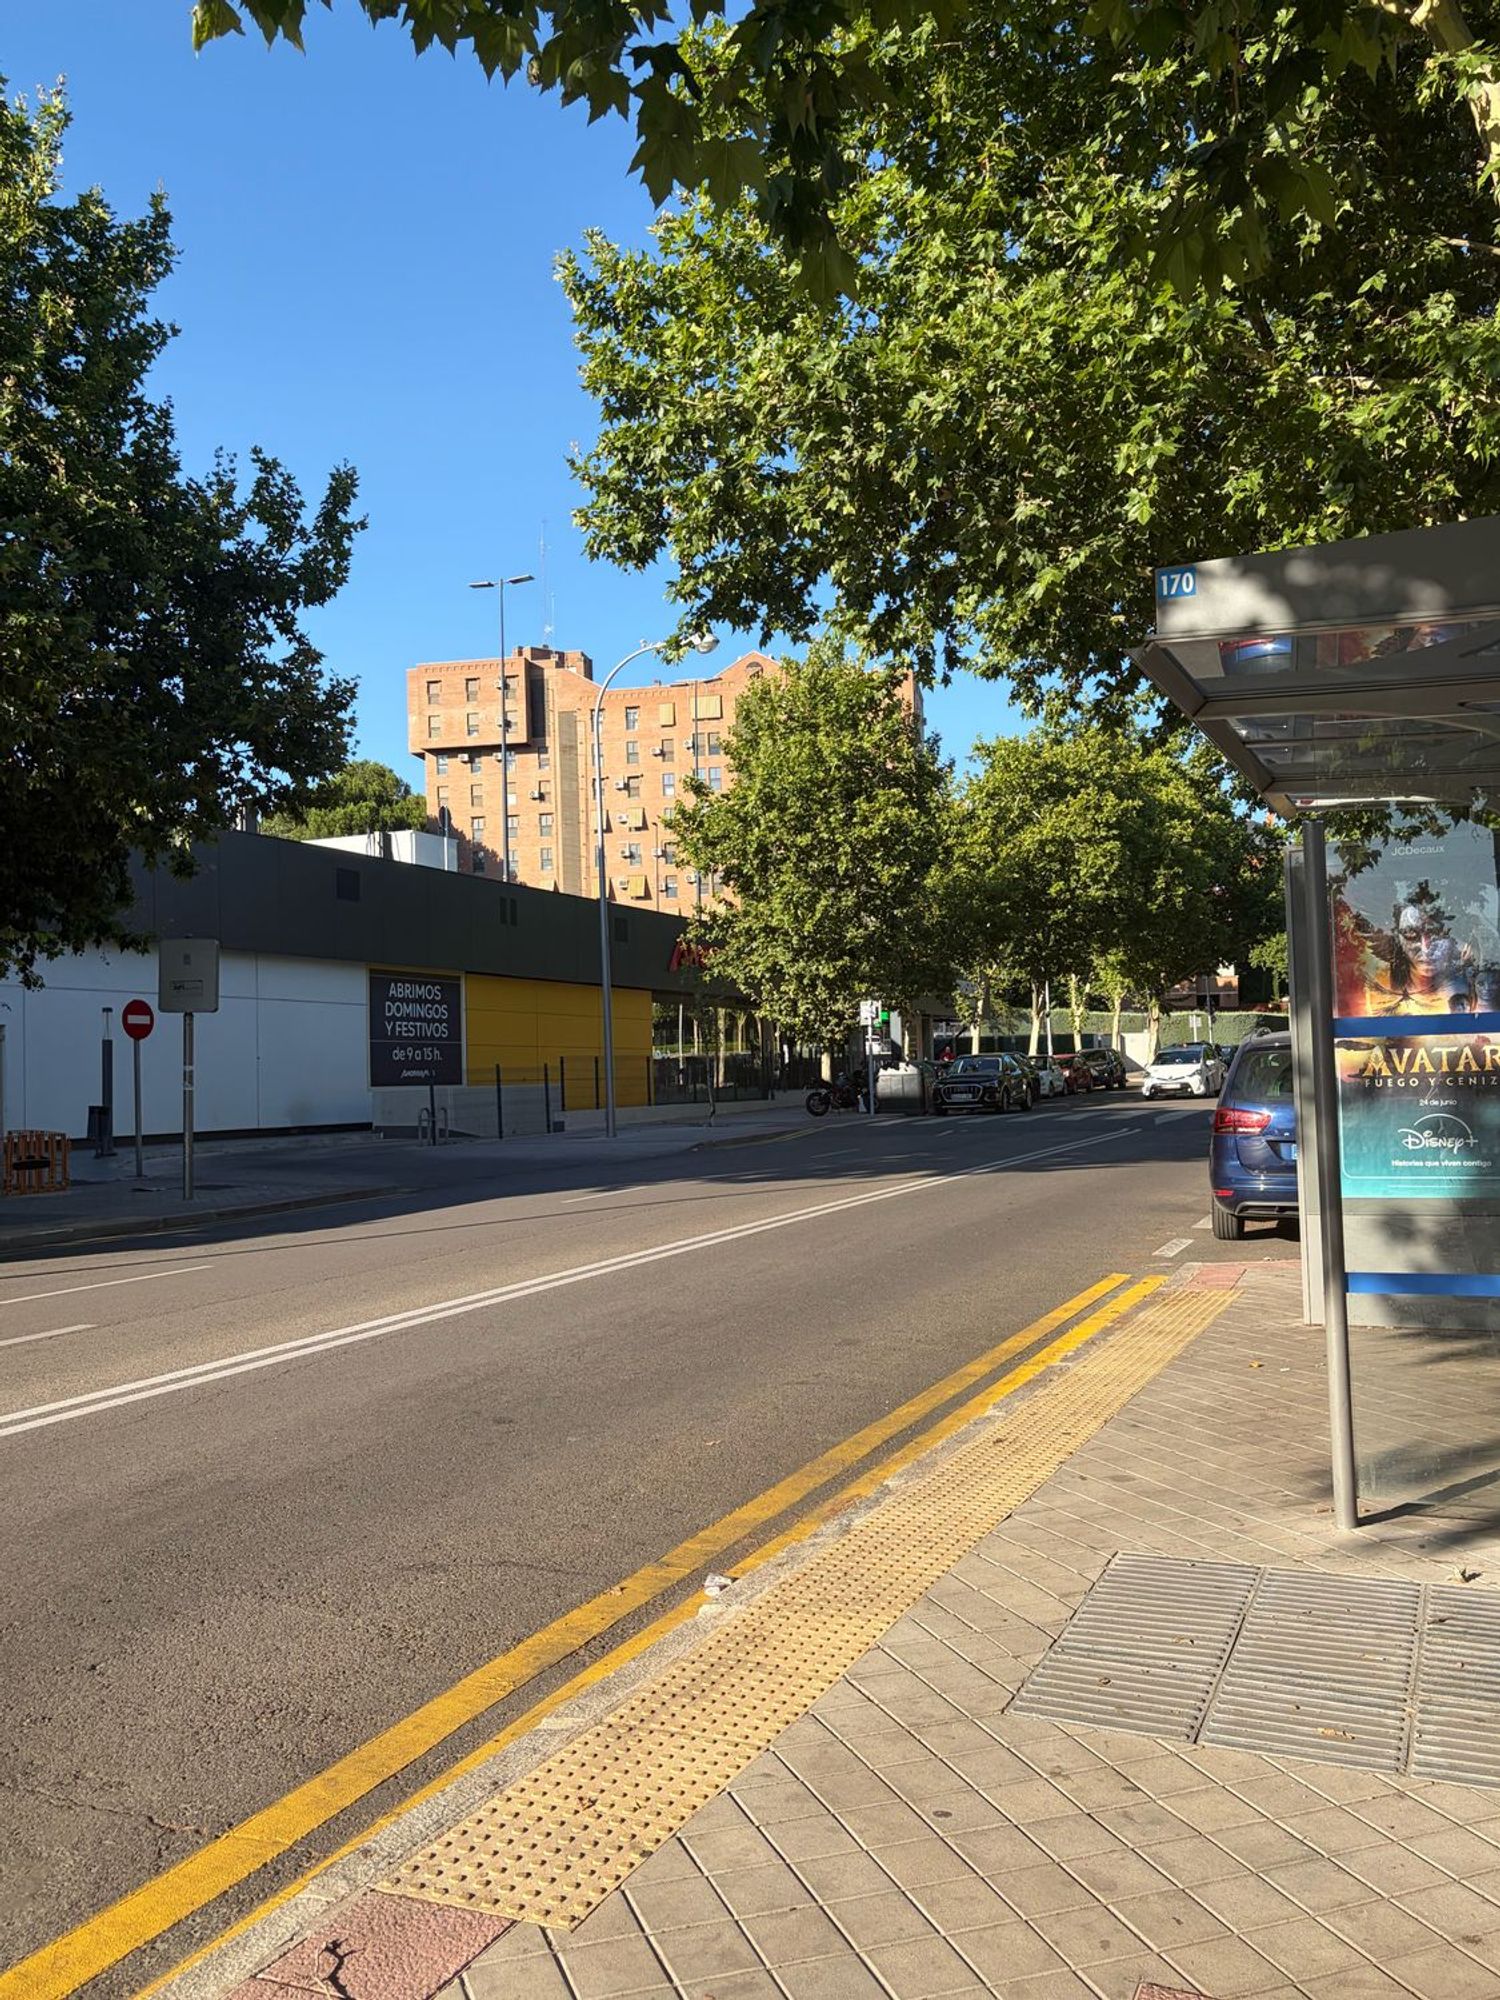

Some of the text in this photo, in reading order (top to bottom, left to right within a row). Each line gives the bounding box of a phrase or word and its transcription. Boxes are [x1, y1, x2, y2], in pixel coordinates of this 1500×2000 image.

[1161, 572, 1194, 596] 170
[1391, 845, 1446, 856] JCDecaux
[389, 983, 441, 1000] ABRIMOS
[385, 1002, 449, 1019] DOMINGOS
[385, 1022, 449, 1038] Y FESTIVOS
[392, 1047, 443, 1061] de 9 a 15 h.
[1362, 1045, 1500, 1077] AVATAR
[1365, 1079, 1419, 1088] FUEGO
[1428, 1077, 1436, 1086] Y
[1419, 1099, 1428, 1107] 24
[1440, 1099, 1457, 1107] junio
[1462, 1160, 1492, 1168] contigo
